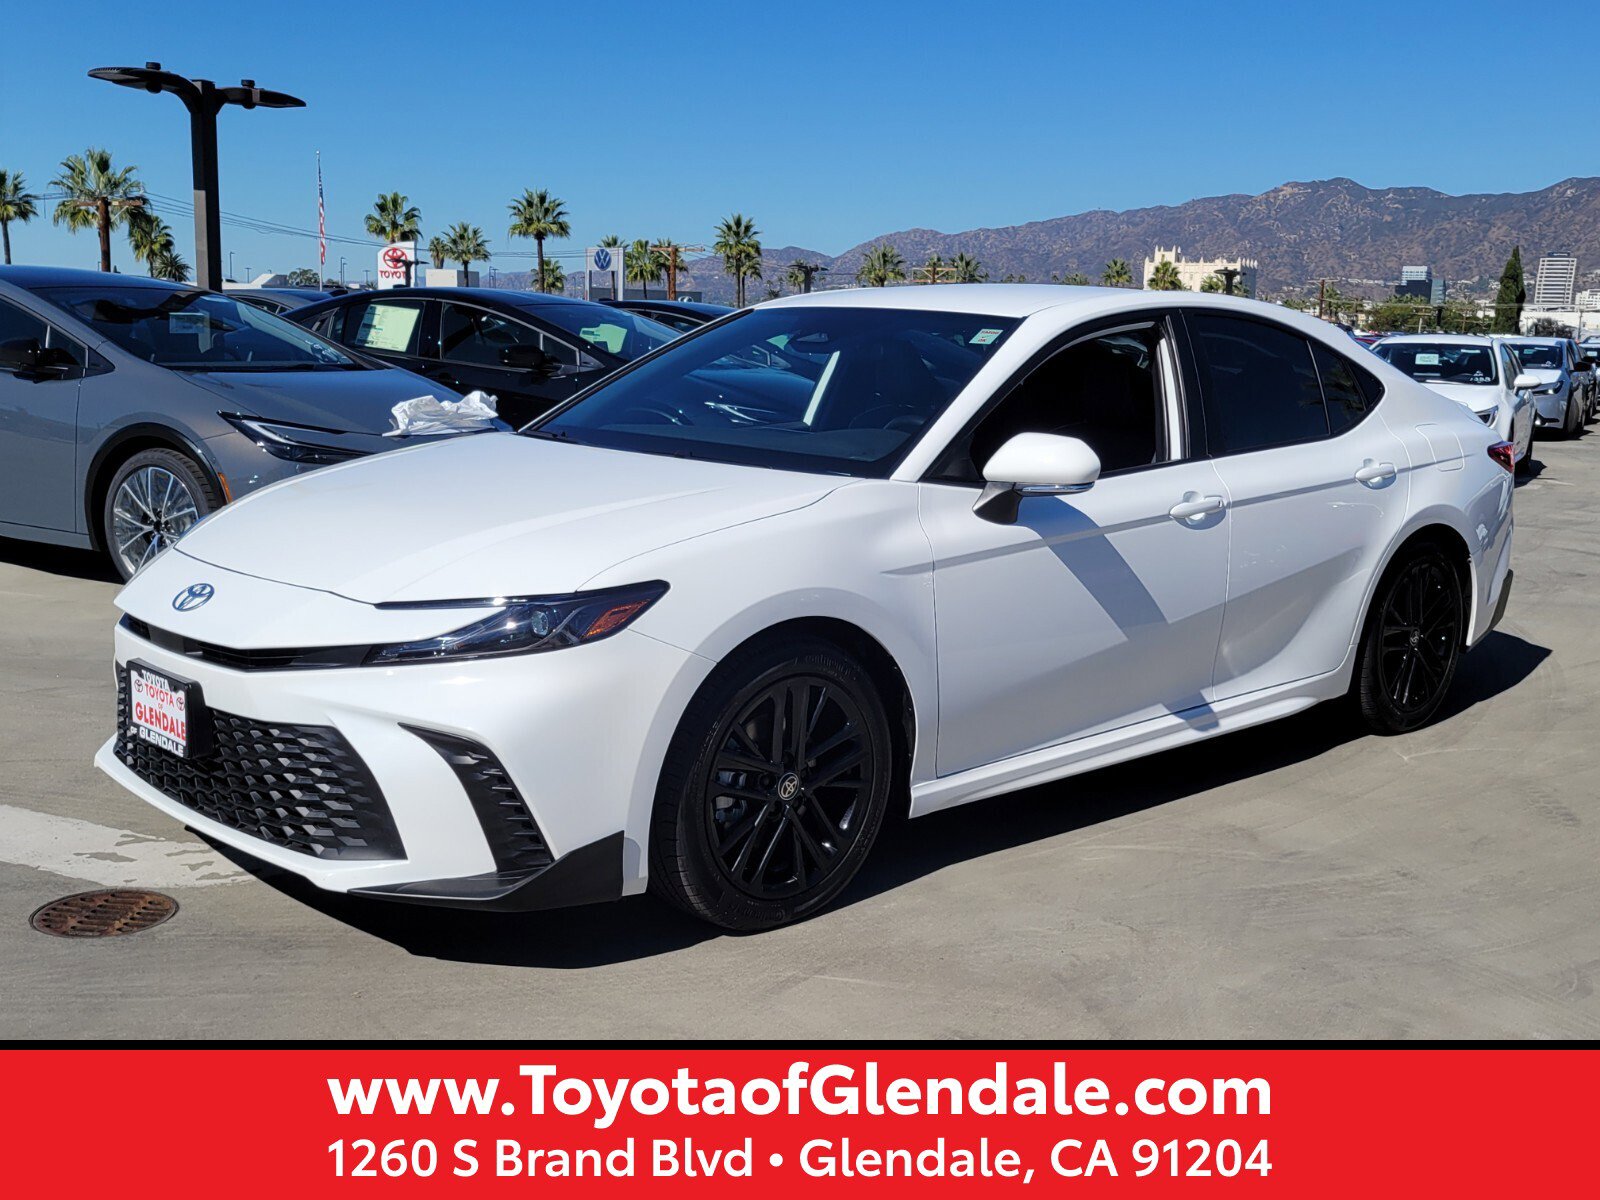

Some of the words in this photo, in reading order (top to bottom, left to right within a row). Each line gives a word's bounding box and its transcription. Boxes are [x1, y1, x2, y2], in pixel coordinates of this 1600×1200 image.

[379, 270, 407, 279] TOYOT
[145, 683, 174, 707] TOYOTA
[135, 702, 186, 740] GLENDALE
[140, 727, 184, 757] GLENDALE
